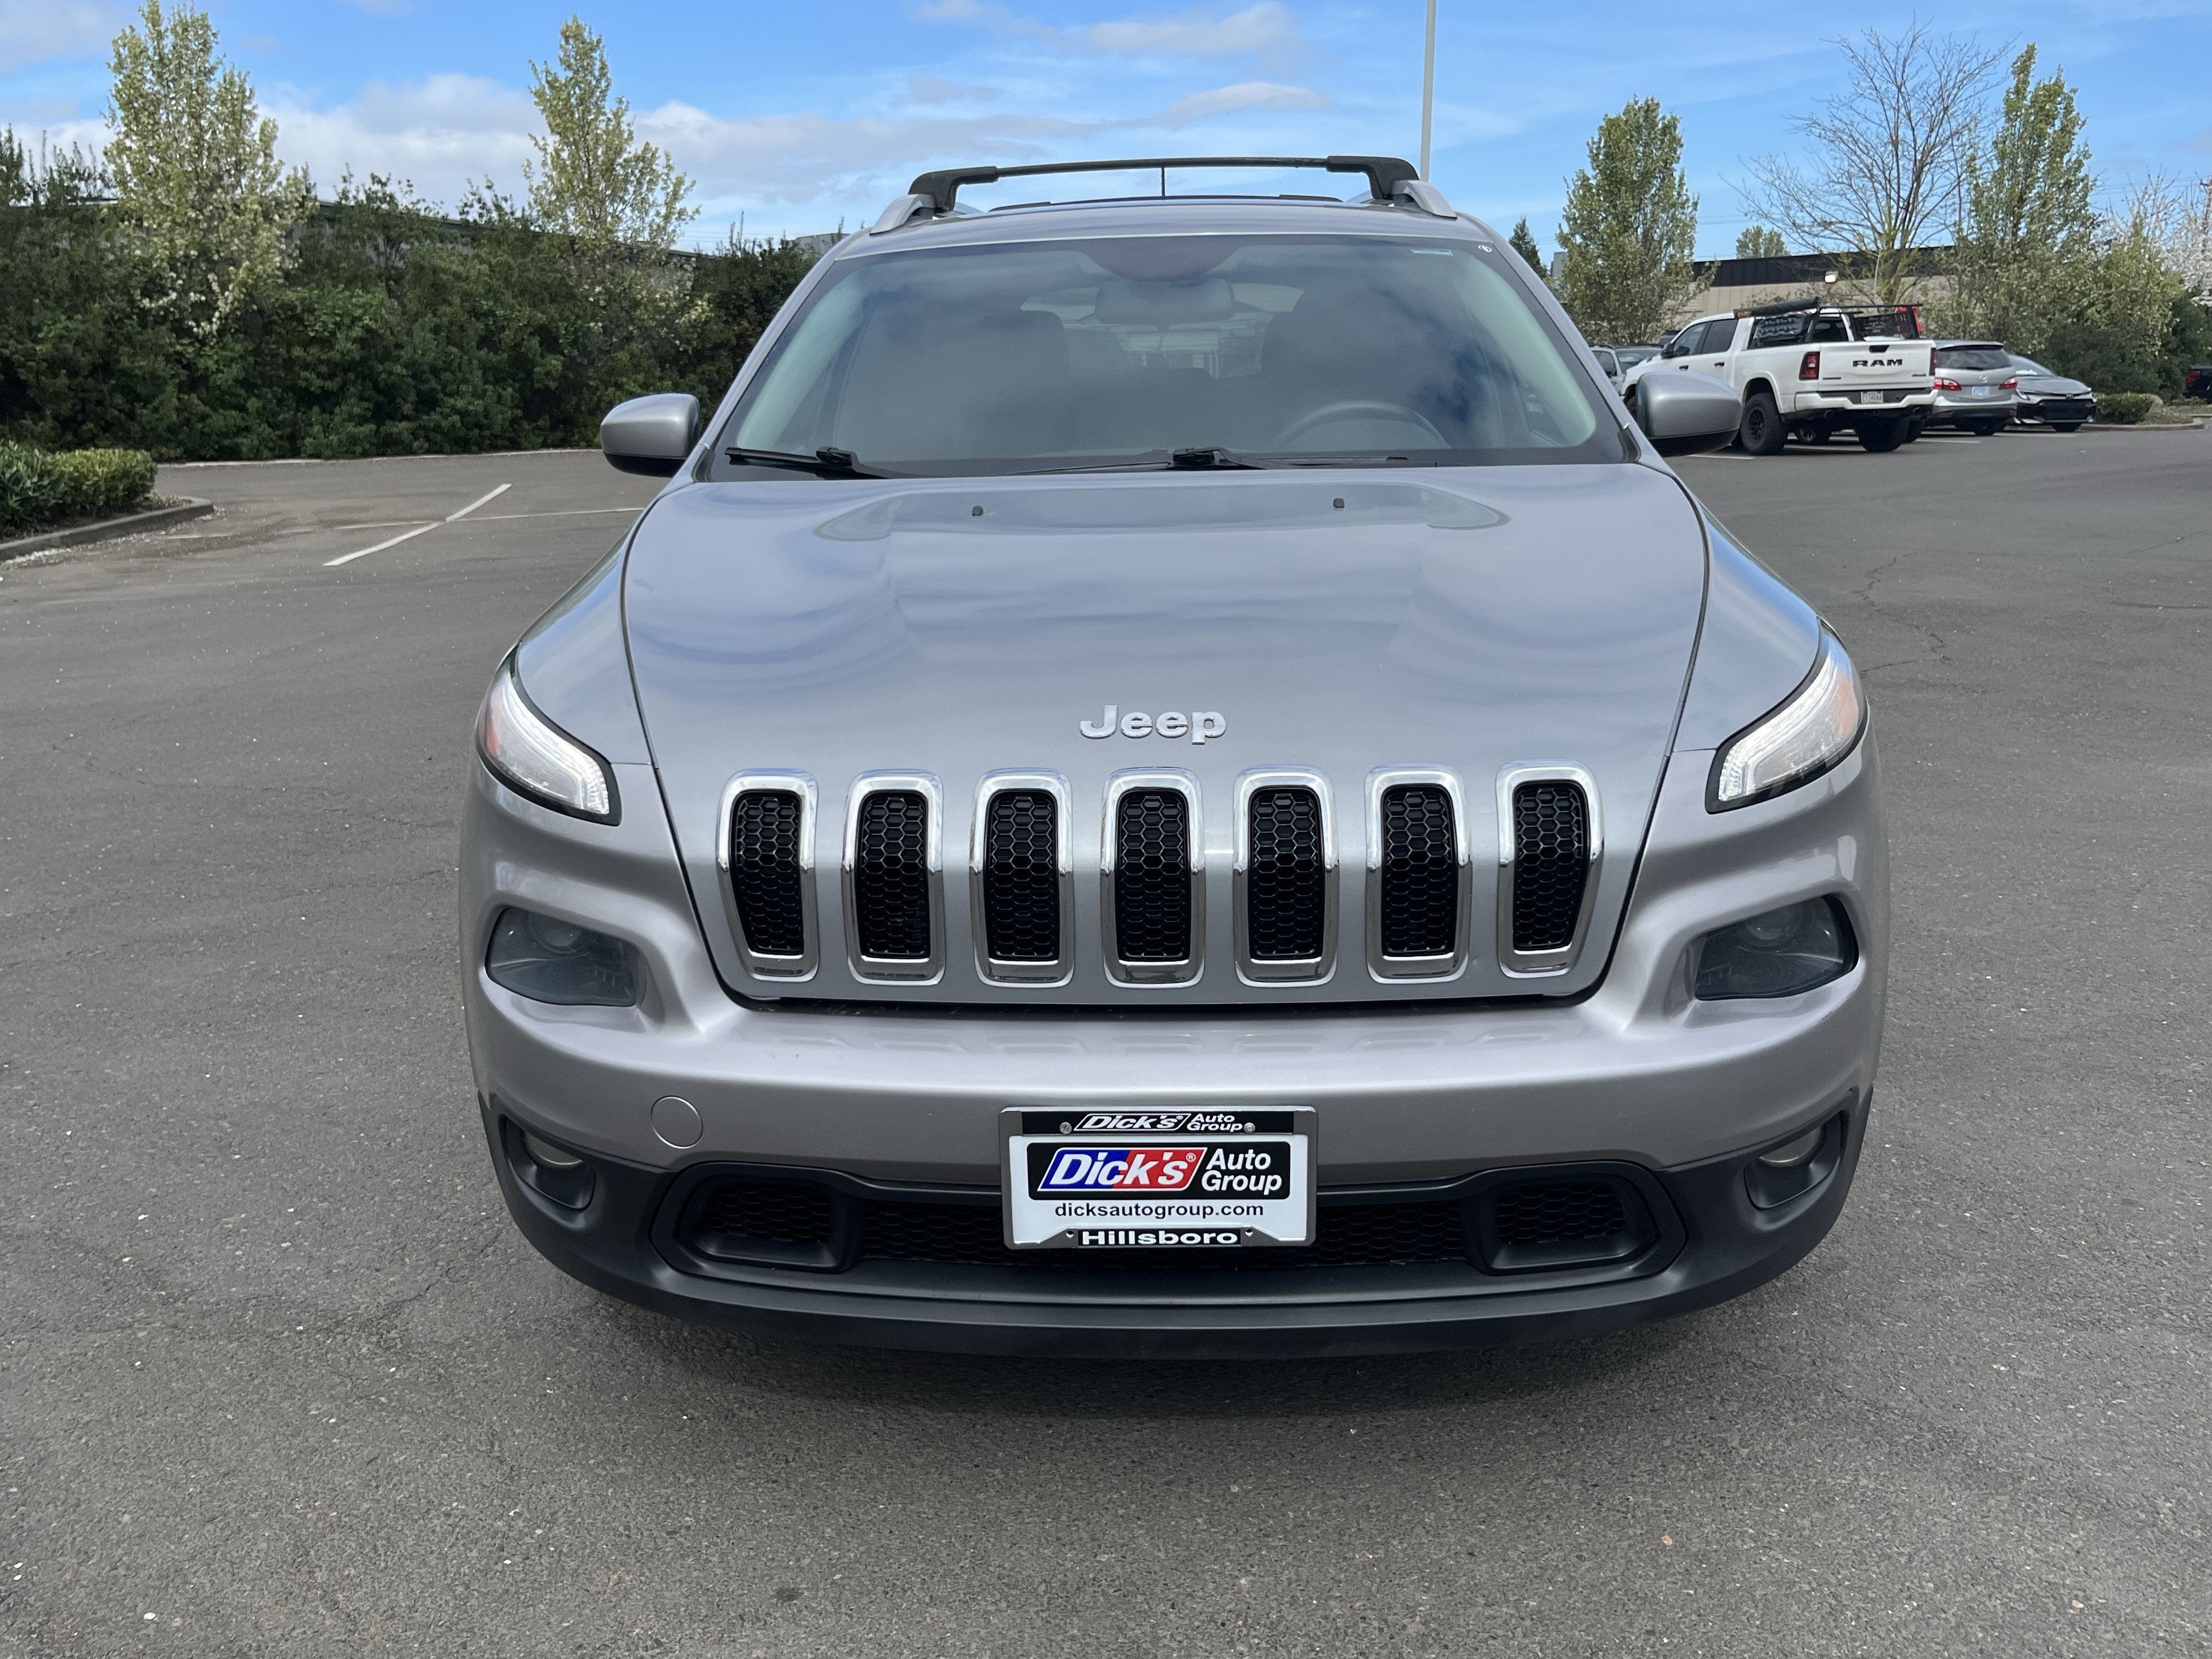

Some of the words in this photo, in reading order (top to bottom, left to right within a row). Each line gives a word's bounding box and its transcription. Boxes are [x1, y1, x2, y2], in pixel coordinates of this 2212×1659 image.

[1853, 359, 1903, 367] RAM
[1079, 704, 1227, 745] Jeep
[1192, 1114, 1235, 1123] Auto
[1187, 1122, 1243, 1132] Group
[1206, 1148, 1271, 1170] Auto
[1049, 1152, 1188, 1186] Dick's
[1201, 1170, 1283, 1195] Group
[1055, 1203, 1263, 1219] dicksautogroup.com
[1082, 1231, 1238, 1245] Hillsboro
